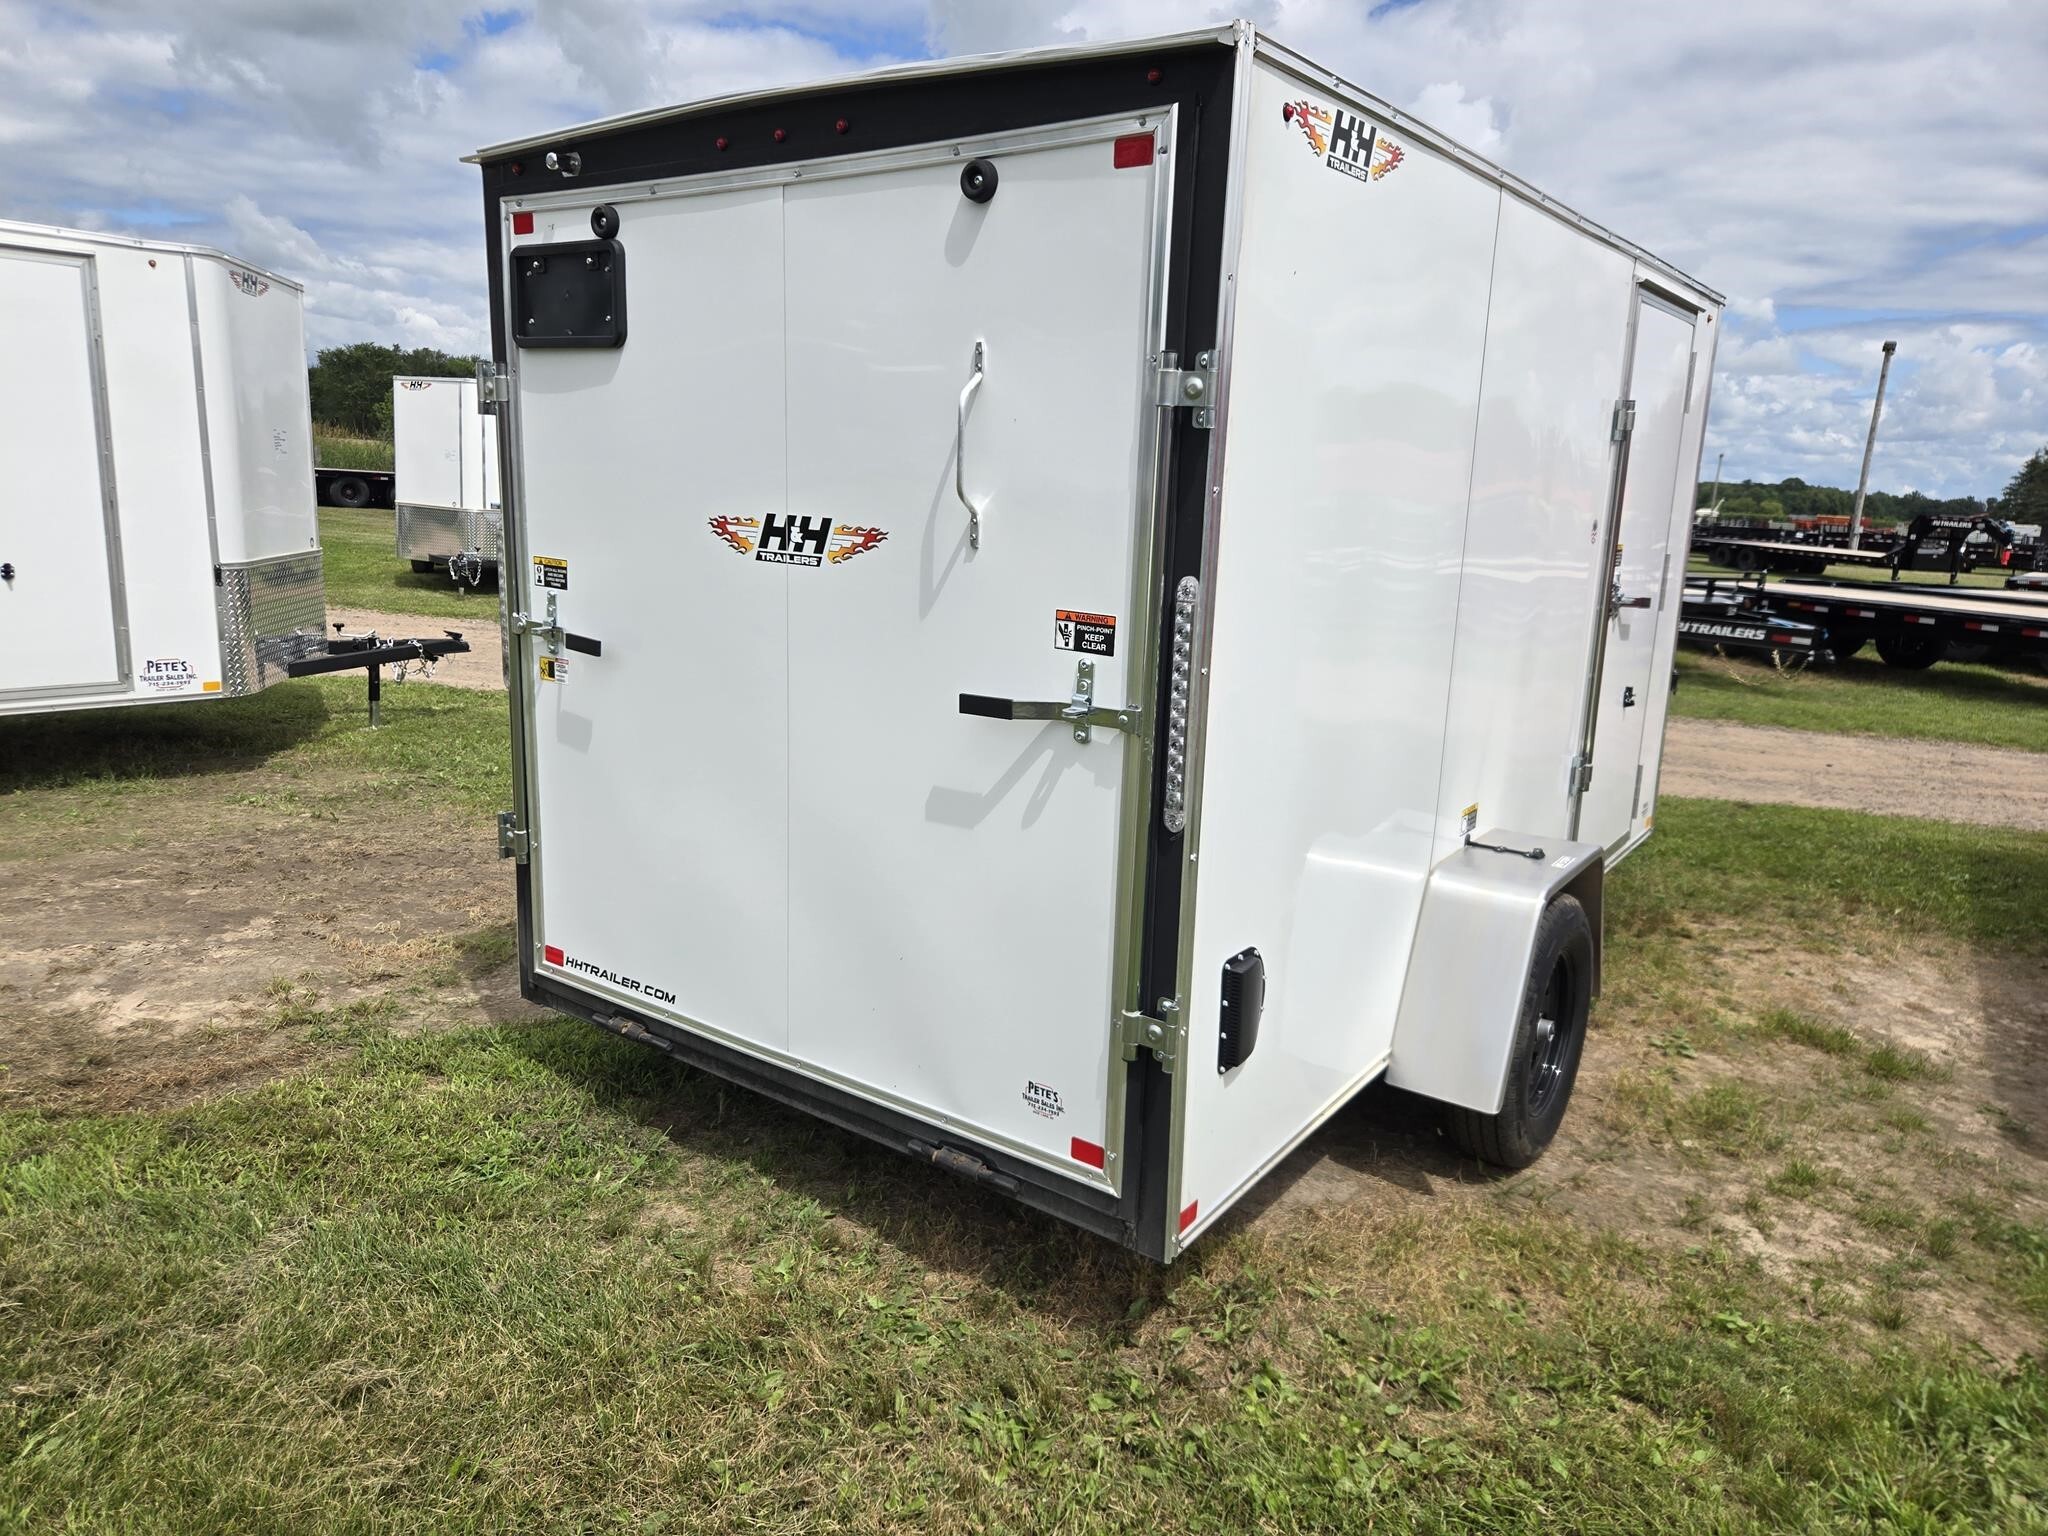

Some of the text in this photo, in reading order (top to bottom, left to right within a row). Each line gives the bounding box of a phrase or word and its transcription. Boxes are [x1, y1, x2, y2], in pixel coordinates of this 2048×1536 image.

[1329, 108, 1377, 169] H&H
[1328, 156, 1367, 182] TRAILERS
[1940, 520, 1973, 529] TRAILERS
[758, 512, 833, 555] H&H
[758, 551, 820, 567] TRAILERS
[1075, 614, 1109, 624] WARNING
[1076, 625, 1114, 635] PINCH-POINT
[1084, 633, 1105, 642] KEEP
[1689, 623, 1767, 640] TRAILERS
[1081, 641, 1107, 651] CLEAR
[146, 660, 188, 673] PETE'S
[565, 956, 677, 1005] HHTRAILER.COM
[1028, 1080, 1059, 1103] PETE'S
[1021, 1092, 1040, 1105] TRAILER
[1040, 1099, 1055, 1110] SALES
